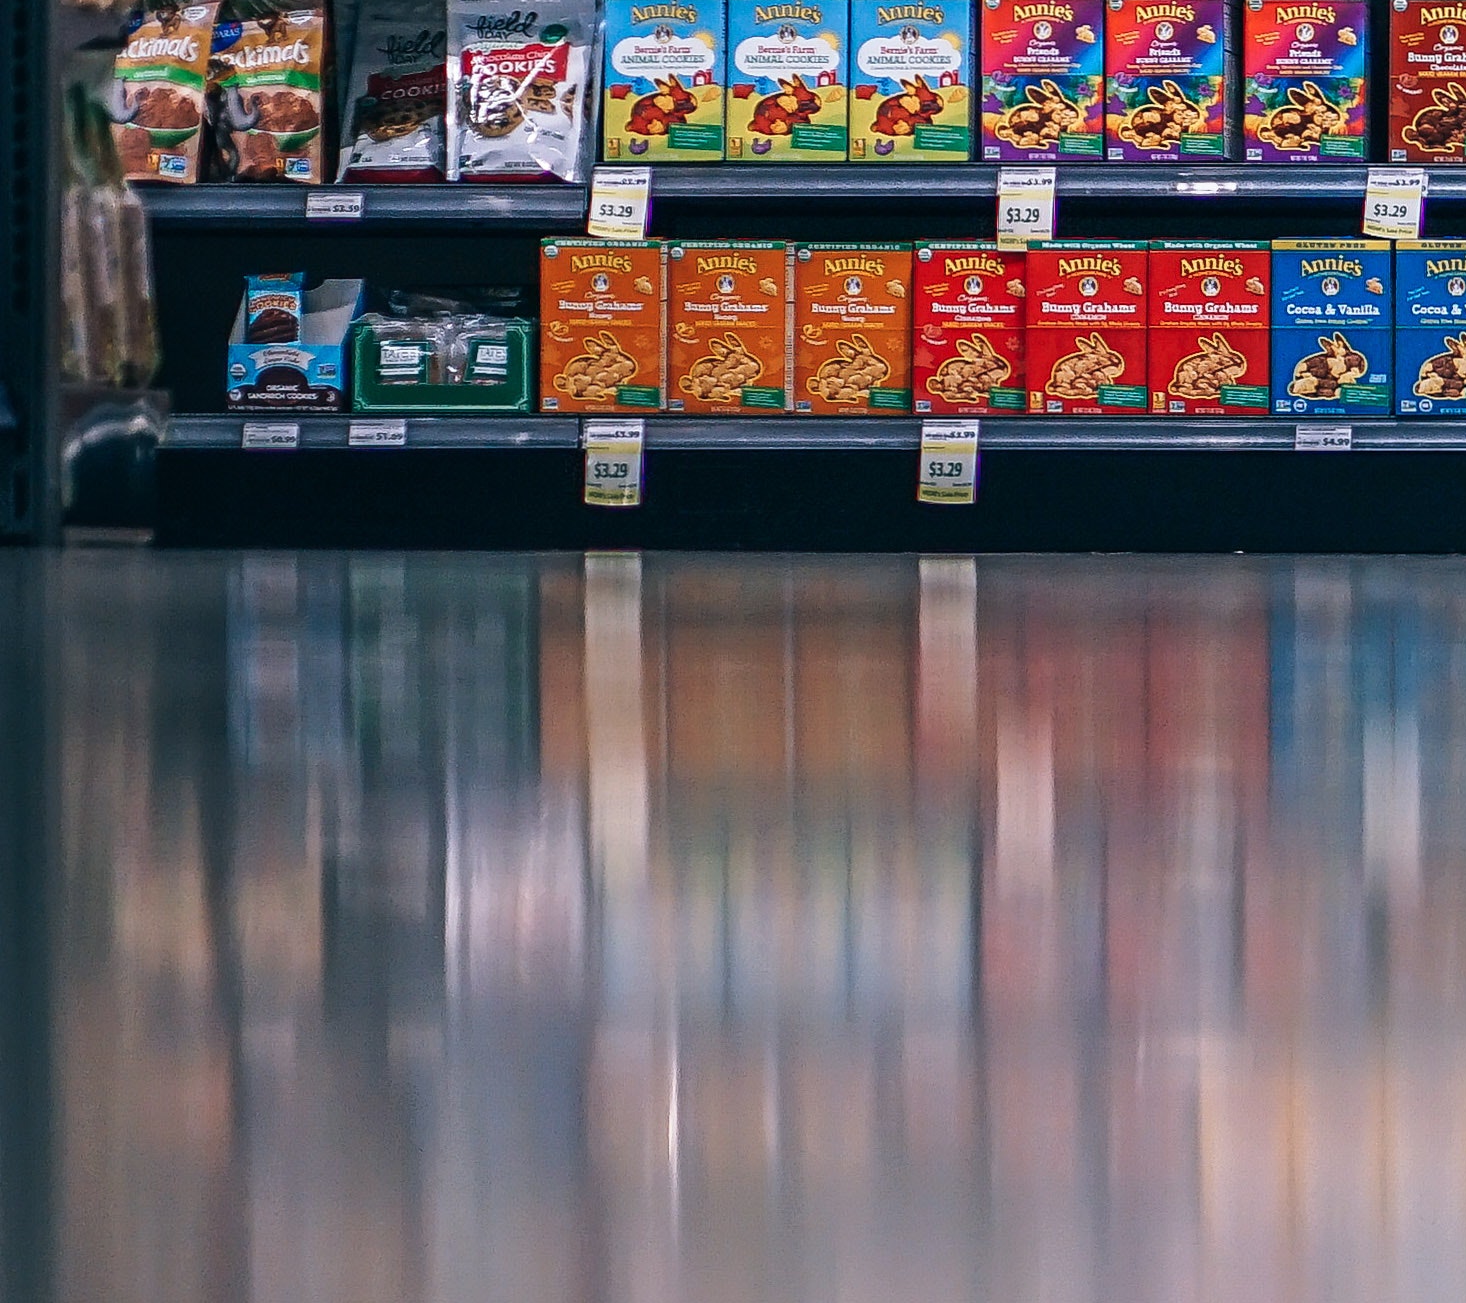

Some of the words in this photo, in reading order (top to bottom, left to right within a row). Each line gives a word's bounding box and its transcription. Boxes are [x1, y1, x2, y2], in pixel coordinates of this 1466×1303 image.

[877, 1, 945, 26] Annie's
[1407, 52, 1441, 65] Bunny
[1006, 207, 1040, 223] $3.29
[1058, 254, 1121, 277] Annie's
[1041, 302, 1076, 315] Bunny
[1080, 302, 1136, 314] Grahams
[1412, 304, 1447, 316] Cocoa
[1450, 304, 1461, 316] &
